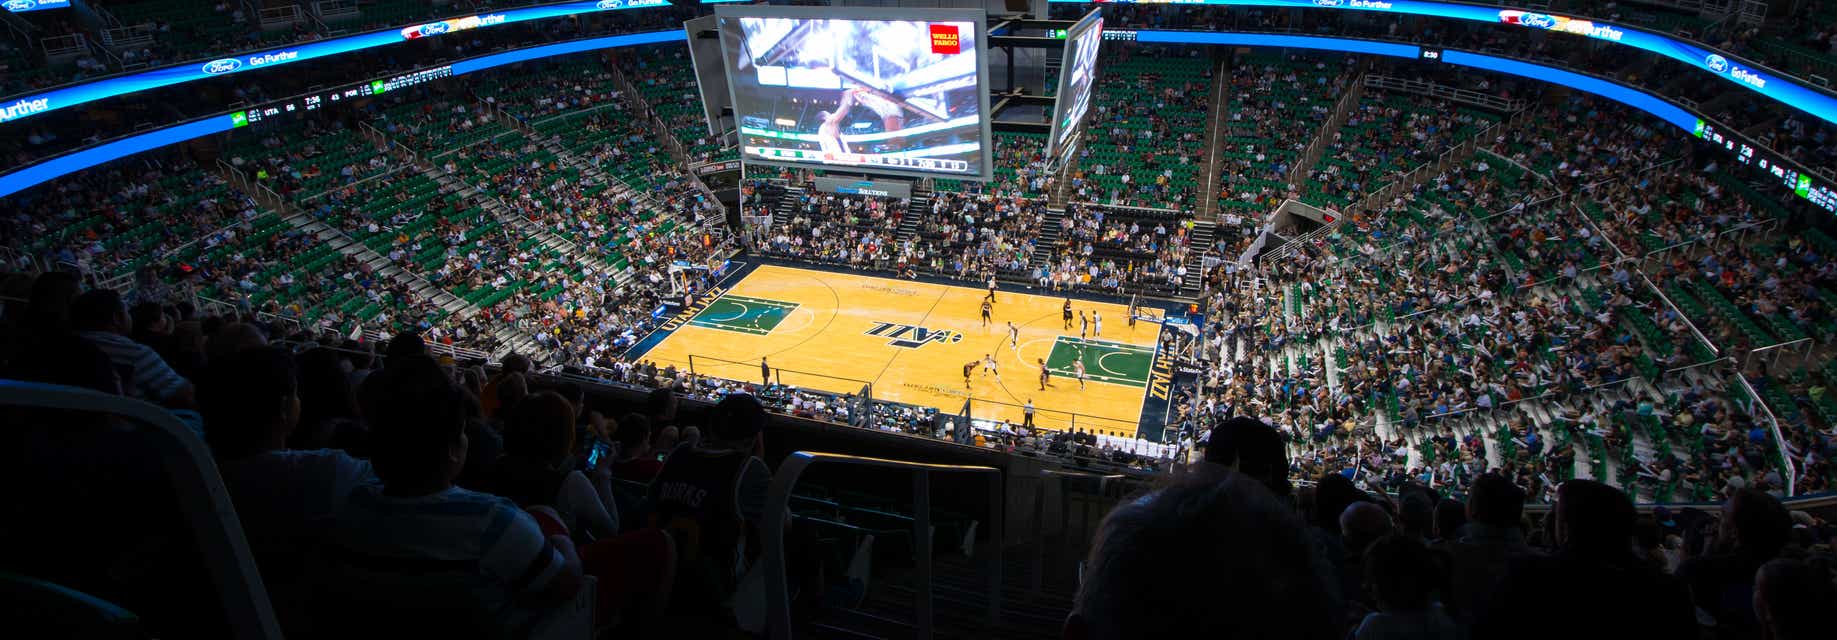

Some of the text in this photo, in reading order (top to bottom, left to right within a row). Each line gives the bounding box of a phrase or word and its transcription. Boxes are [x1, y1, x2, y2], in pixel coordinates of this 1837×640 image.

[250, 57, 264, 65] Go
[265, 51, 298, 63] Further
[1731, 66, 1741, 78] Go
[1741, 70, 1766, 88] Further
[0, 98, 49, 121] urther
[264, 108, 280, 116] UTA
[345, 90, 358, 98] POR
[661, 305, 700, 332] UTAH
[695, 286, 728, 307] JAZZ
[1149, 369, 1172, 400] JAZZ
